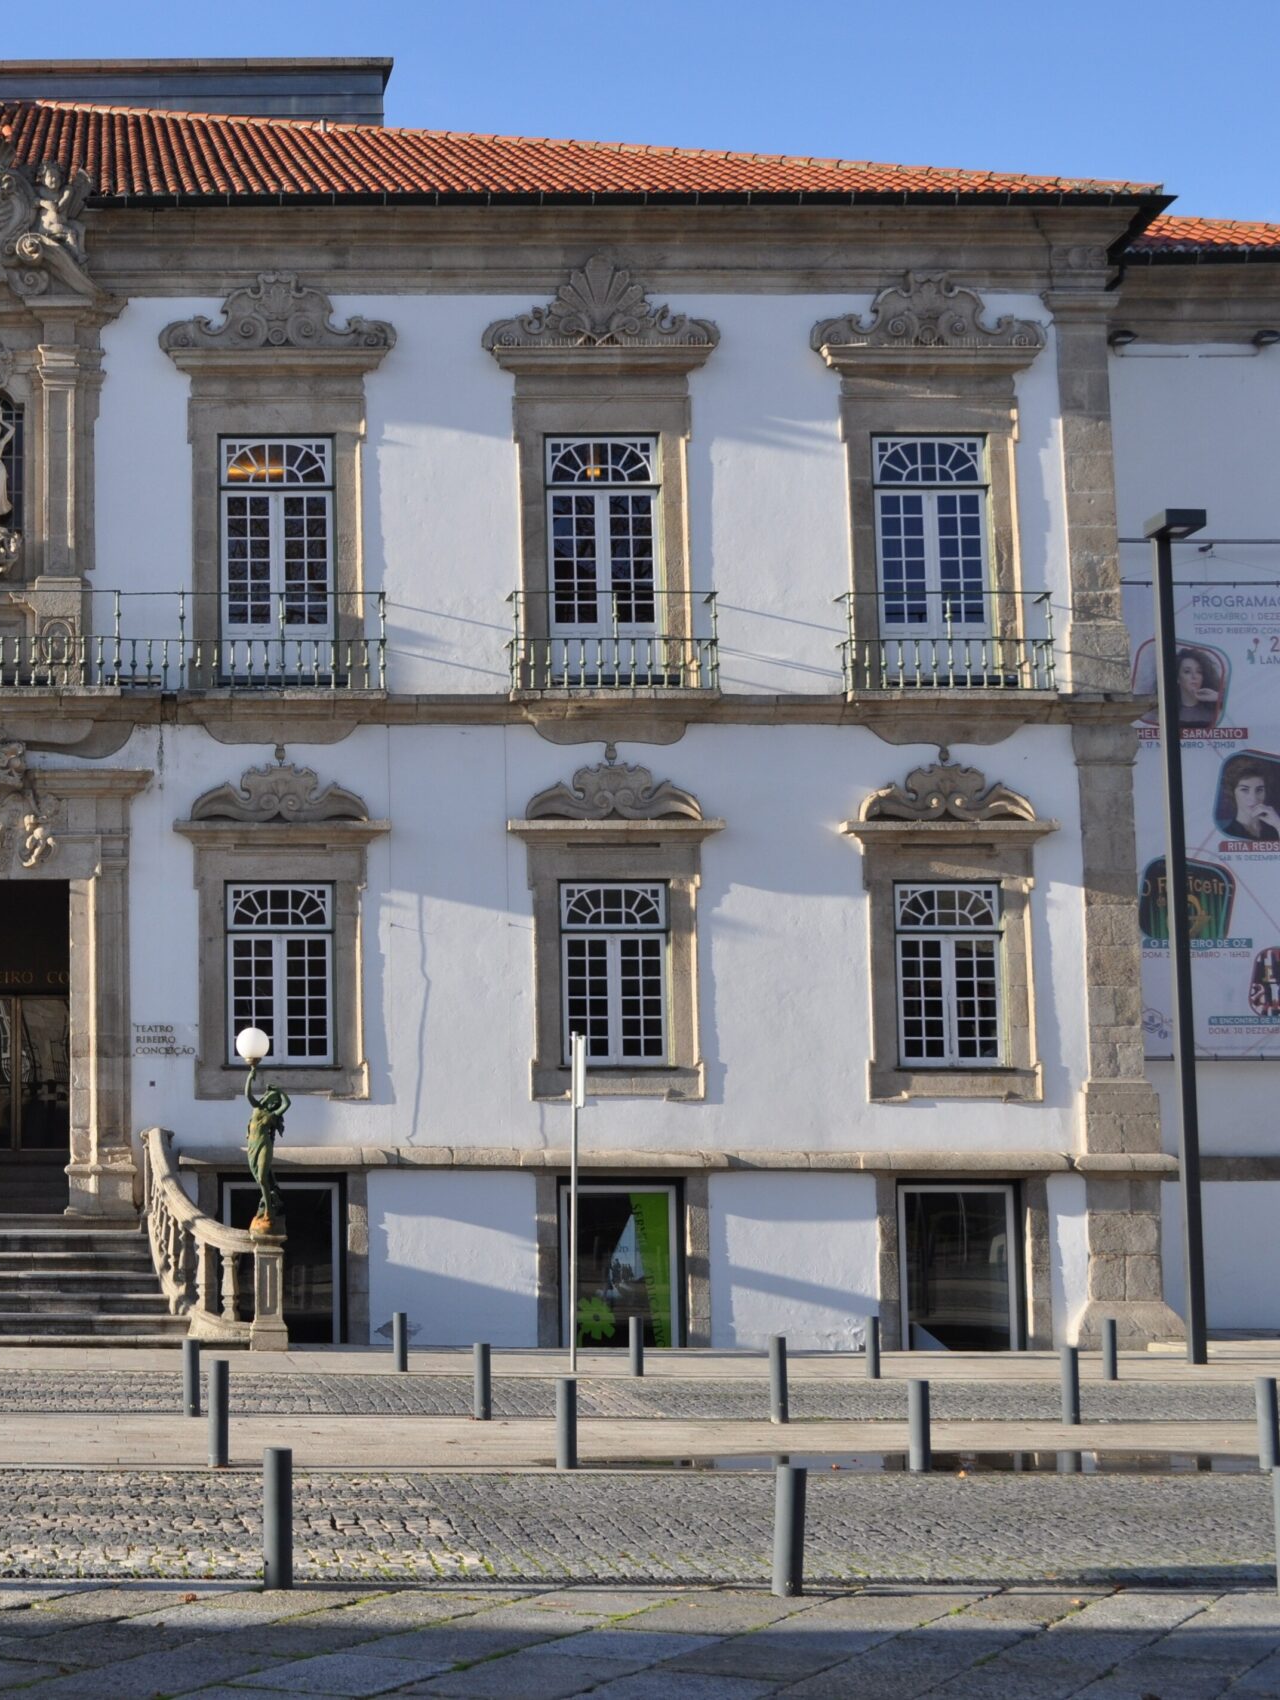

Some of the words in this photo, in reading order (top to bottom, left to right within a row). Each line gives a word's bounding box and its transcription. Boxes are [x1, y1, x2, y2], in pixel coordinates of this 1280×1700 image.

[1193, 612, 1248, 621] NOVEMBRO
[1182, 729, 1244, 739] SARMENTO
[1227, 842, 1249, 851] RITA
[1150, 939, 1159, 948] O
[1217, 939, 1230, 948] DE
[1232, 939, 1248, 948] OZ
[135, 1025, 174, 1033] TEATRO
[135, 1036, 176, 1044] RIBEIRO
[135, 1045, 196, 1057] CONCEIÇÃO
